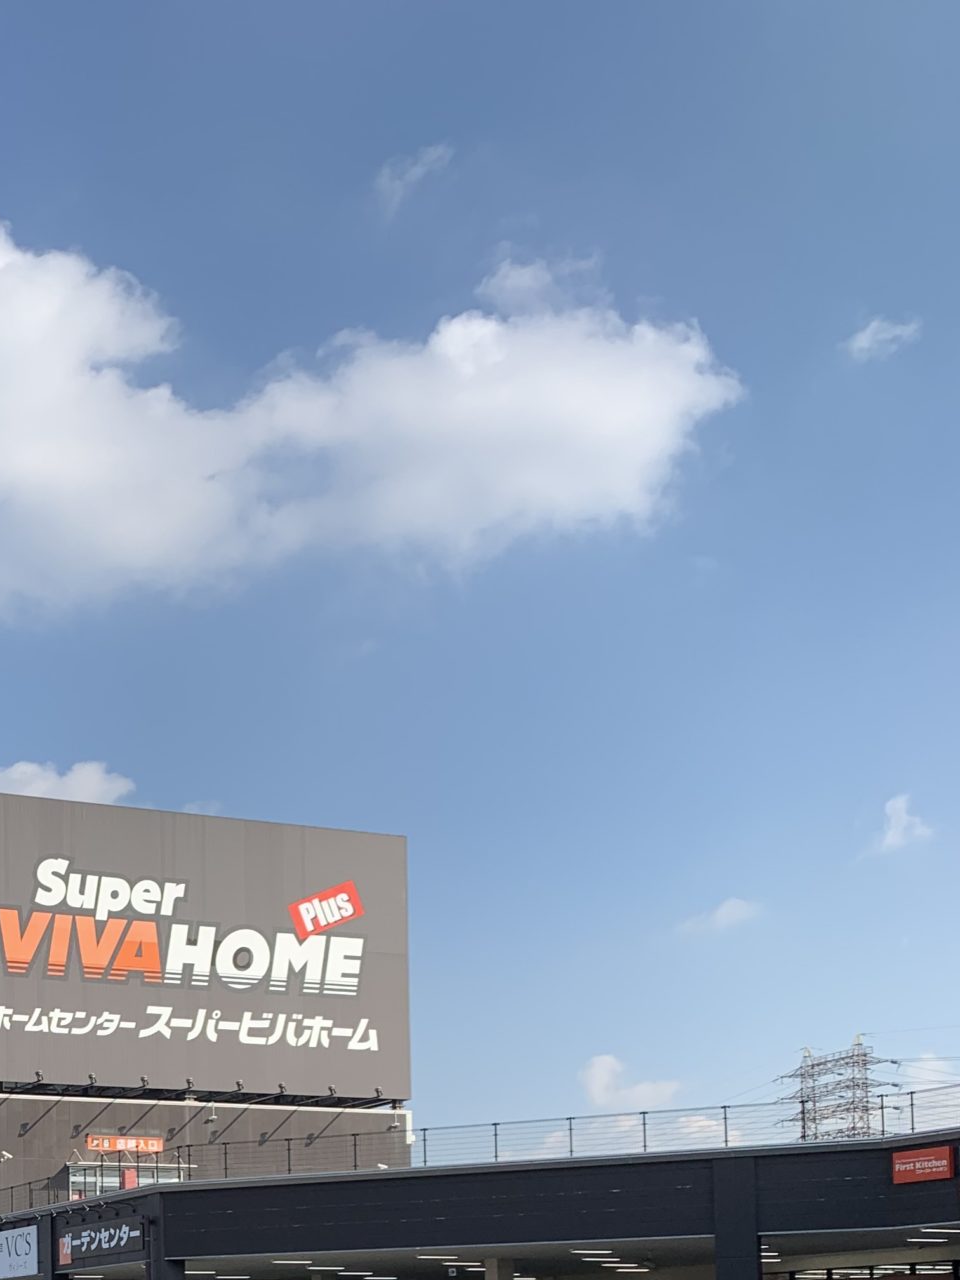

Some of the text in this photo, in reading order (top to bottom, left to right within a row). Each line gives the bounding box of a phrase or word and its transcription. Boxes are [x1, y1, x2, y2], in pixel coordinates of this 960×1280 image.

[34, 856, 186, 921] Super
[298, 891, 355, 932] Plus
[138, 1004, 379, 1051] スーパービバホーム
[895, 1163, 914, 1172] First
[915, 1160, 948, 1169] Kitchen
[5, 1232, 32, 1258] VC'S
[63, 1224, 141, 1254] ガーデンセンター
